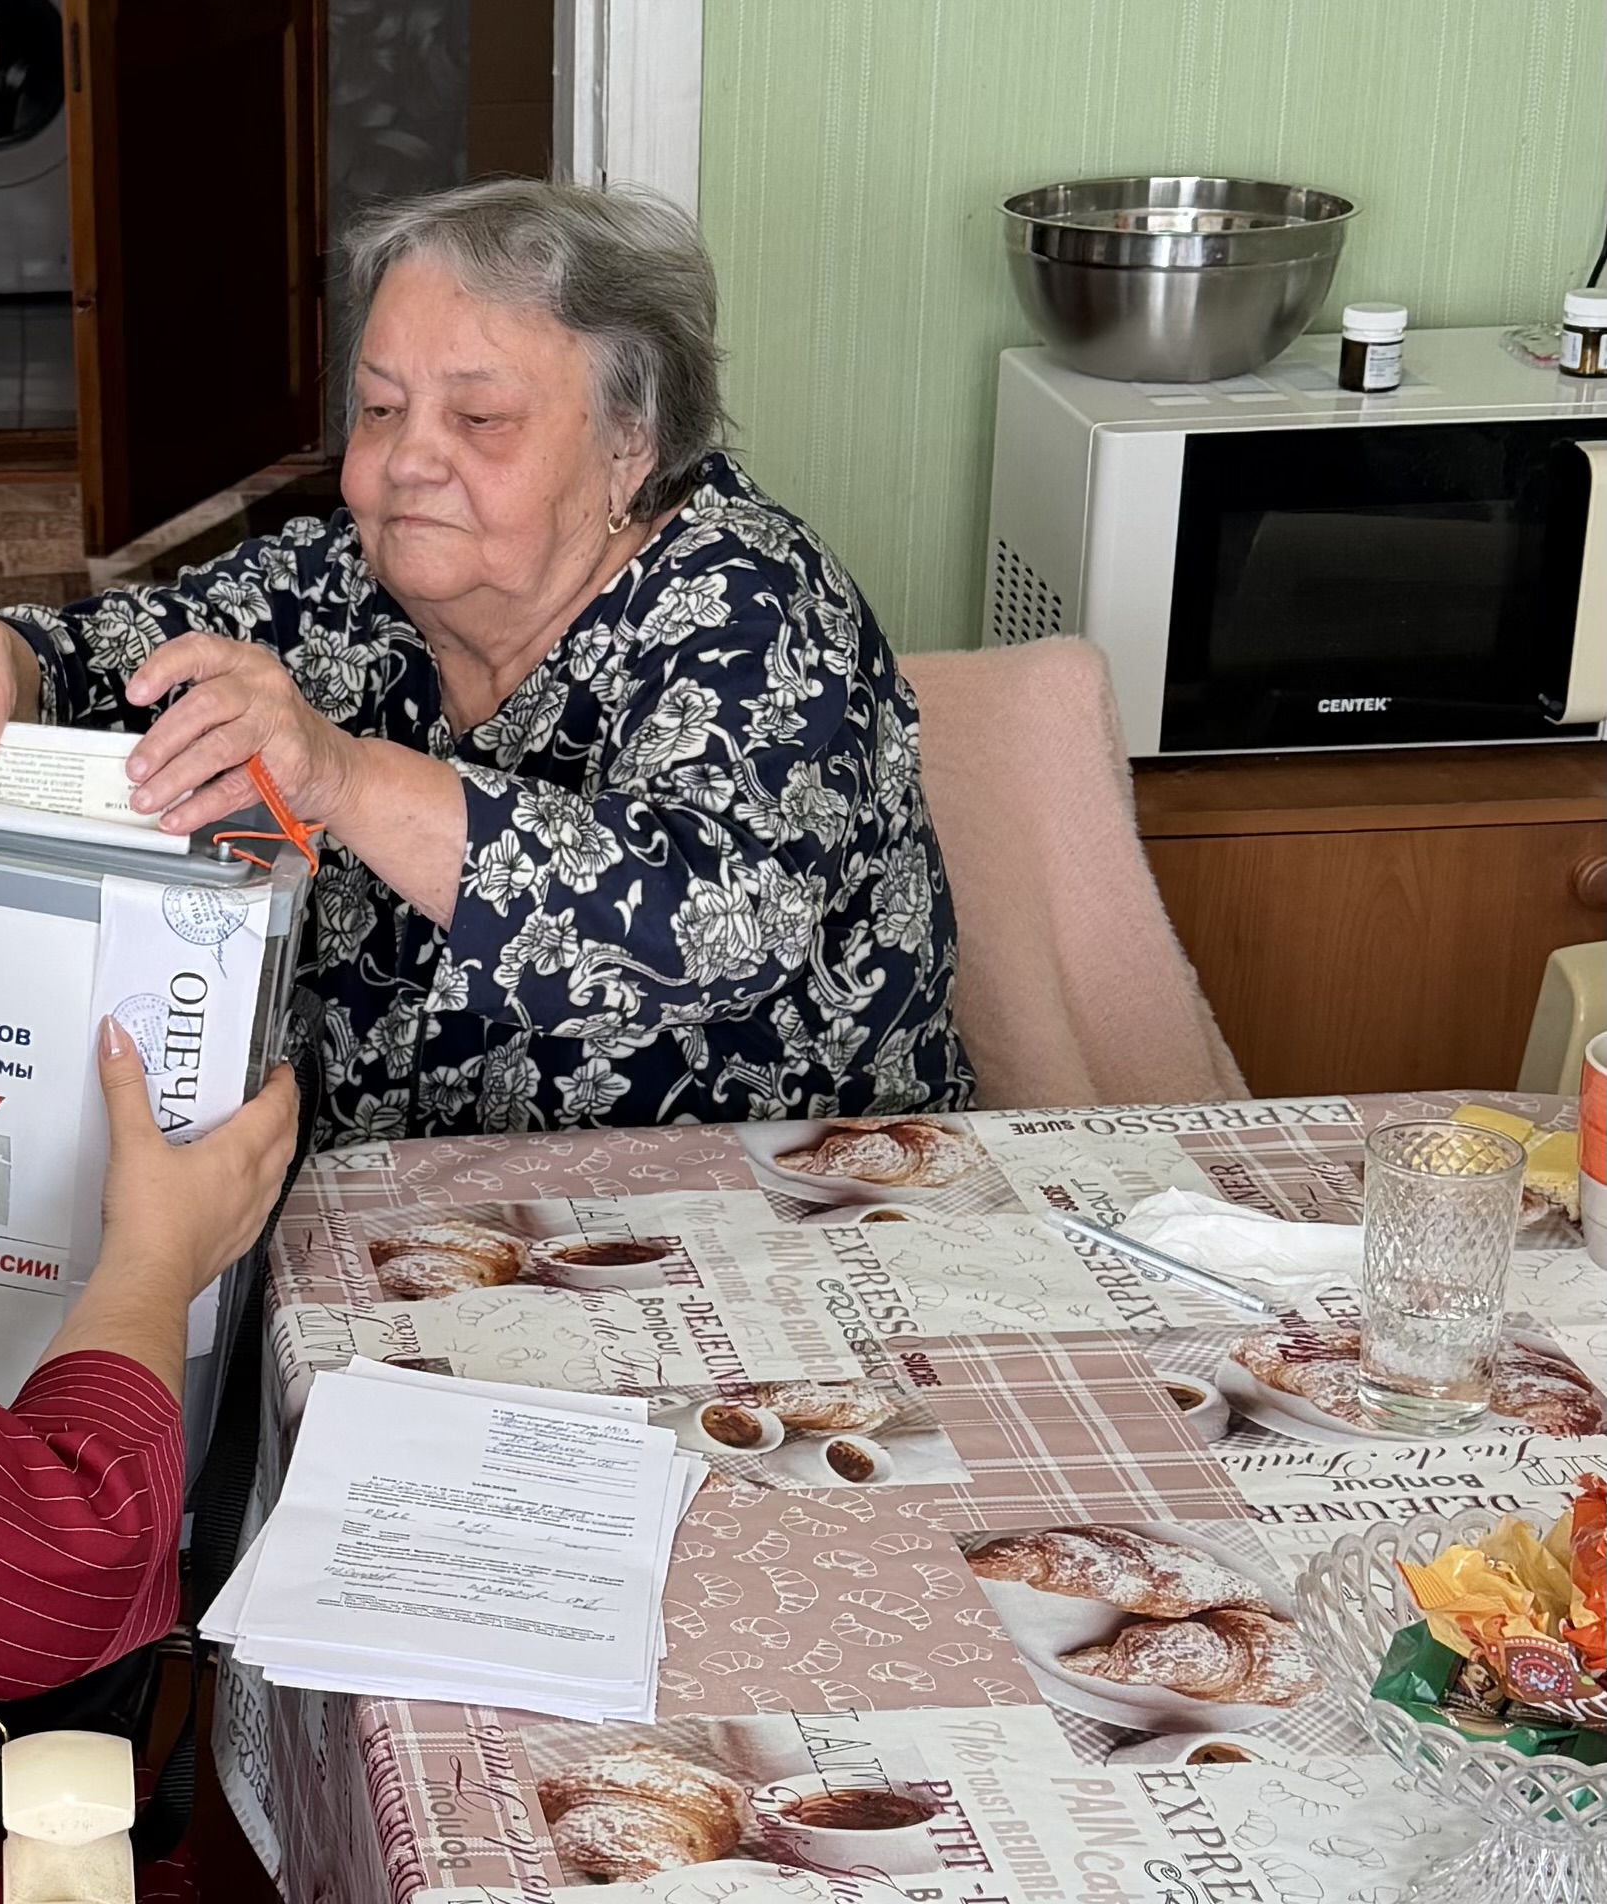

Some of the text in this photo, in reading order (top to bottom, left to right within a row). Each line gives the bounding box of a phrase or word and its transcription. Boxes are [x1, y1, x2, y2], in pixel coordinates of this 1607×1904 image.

[1317, 697, 1387, 713] CENTEK
[820, 1227, 926, 1347] EXPRESSO
[636, 1296, 682, 1357] Bonjour
[1331, 1473, 1485, 1493] Bonjour
[424, 1776, 472, 1871] Bonjour
[483, 1825, 544, 1867] de
[905, 1778, 995, 1874] PETIT
[1050, 1776, 1148, 1847] PAIN
[989, 1819, 1066, 1902] BEURRE
